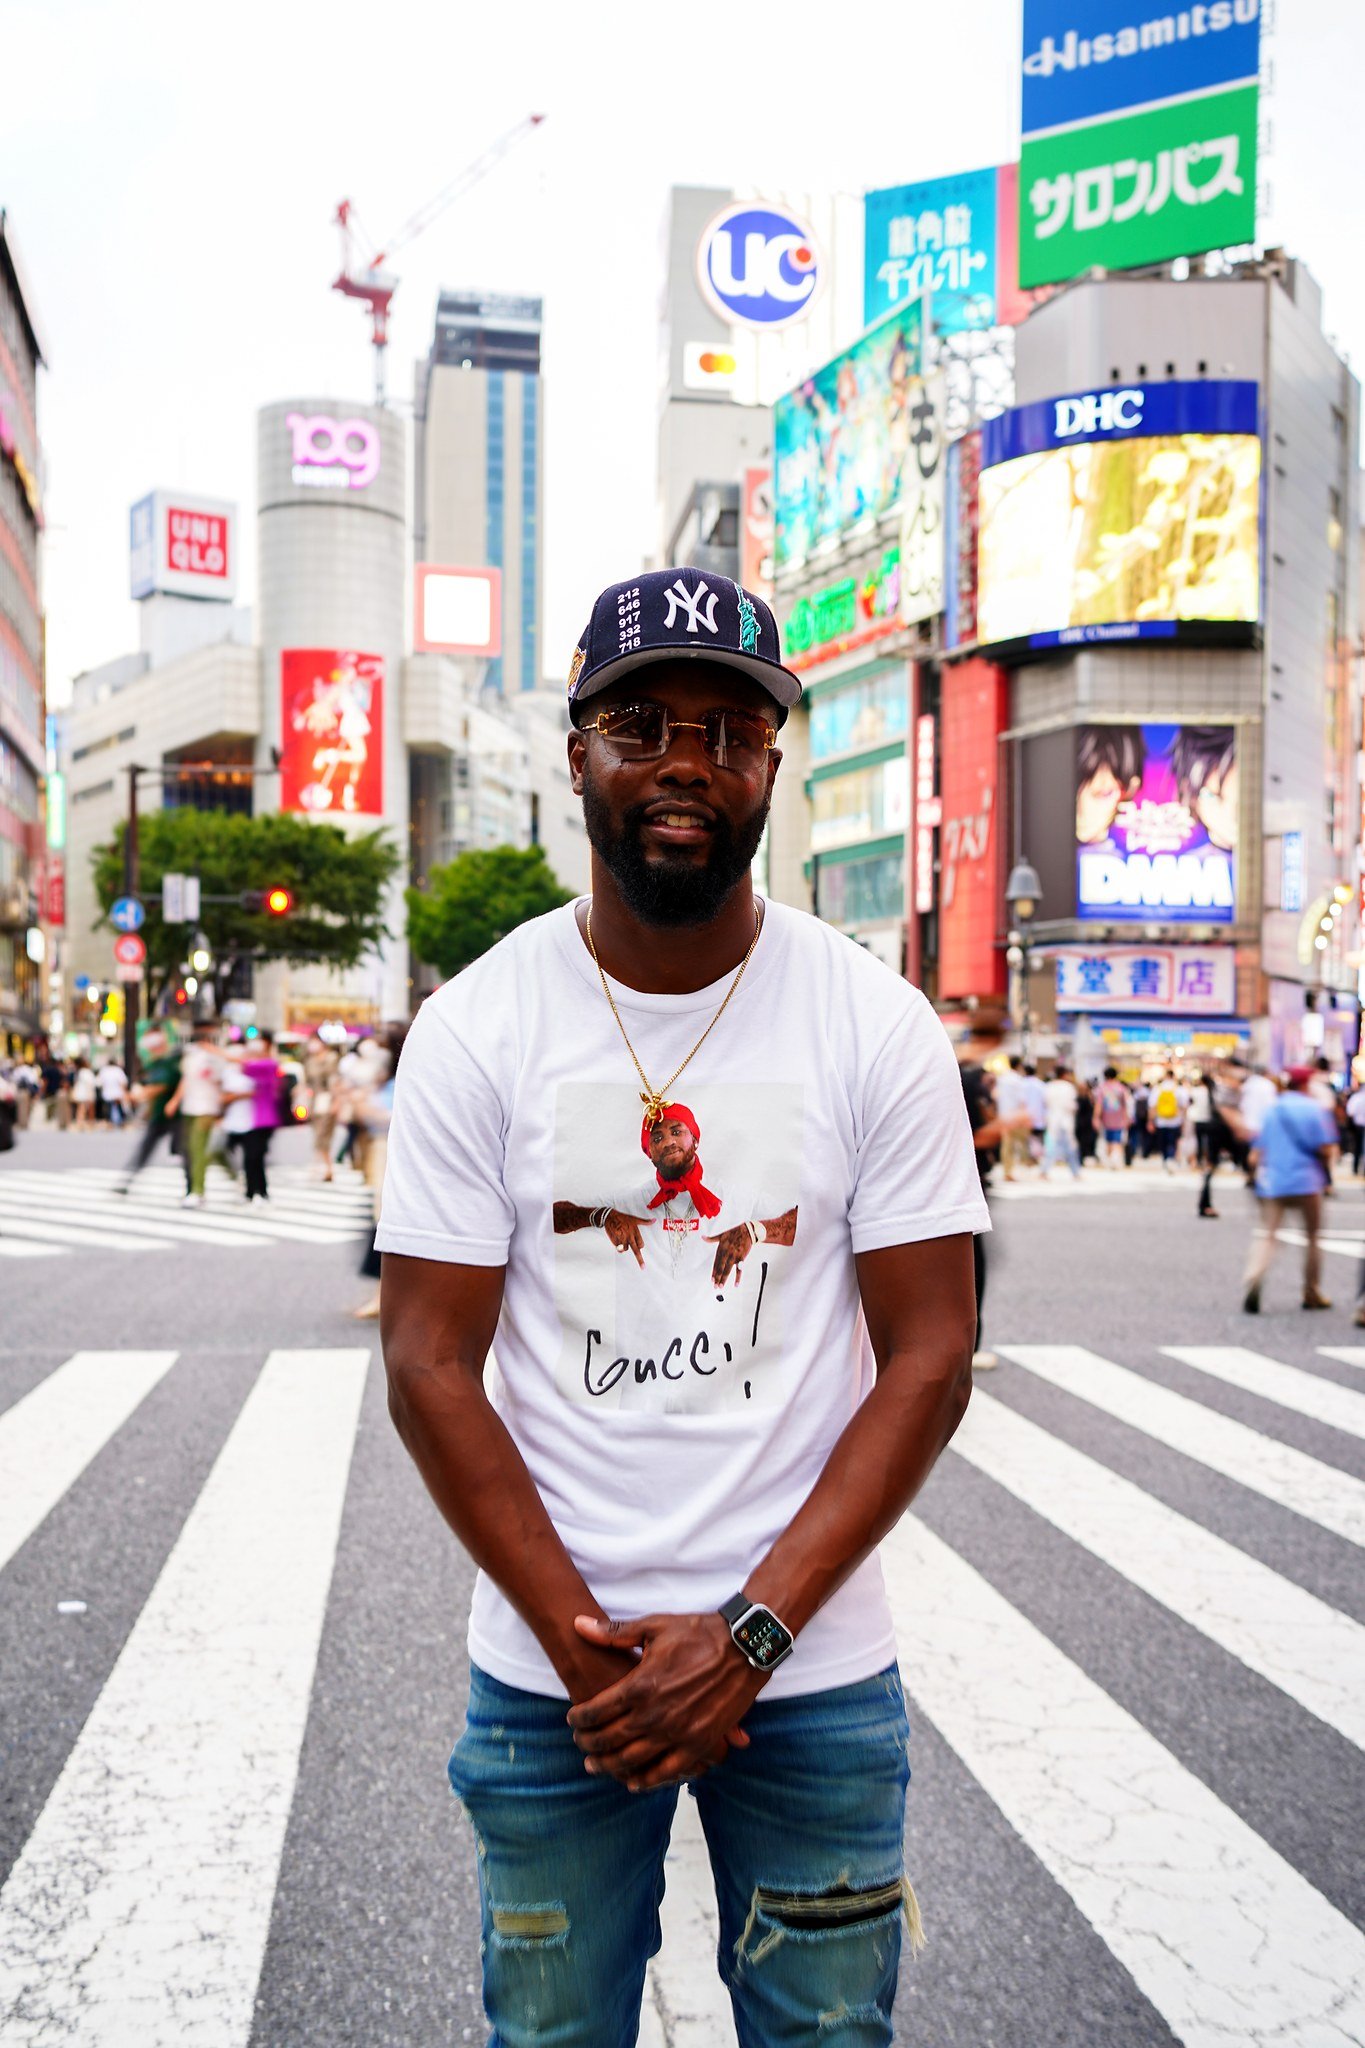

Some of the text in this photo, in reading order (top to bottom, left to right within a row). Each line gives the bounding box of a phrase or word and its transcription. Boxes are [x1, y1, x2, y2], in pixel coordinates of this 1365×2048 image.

[1023, 0, 1259, 76] Hisamitsu
[1030, 135, 1244, 239] サロンパス
[1054, 390, 1145, 438] DHC
[285, 412, 381, 490] 109
[171, 513, 221, 544] UNI
[170, 541, 224, 573] QLO
[618, 588, 640, 603] 212
[618, 600, 640, 615] 646
[663, 578, 720, 635] NY
[619, 612, 641, 628] 917
[619, 626, 641, 640] 332
[619, 637, 641, 654] 718
